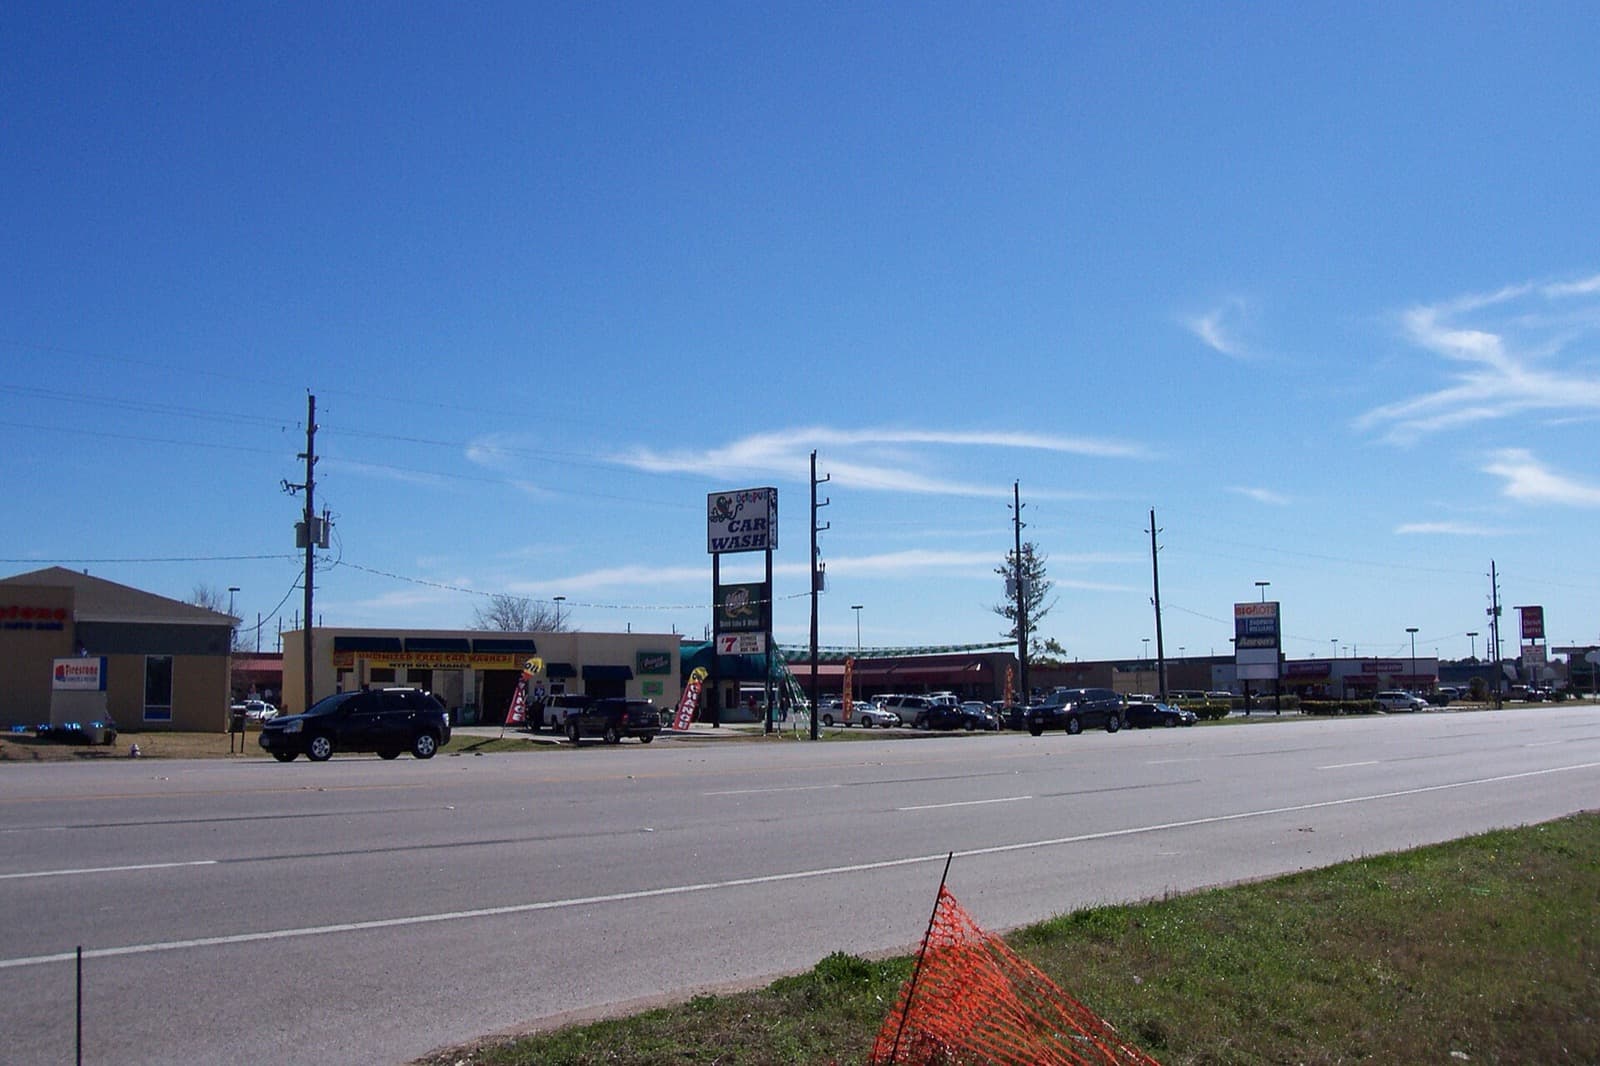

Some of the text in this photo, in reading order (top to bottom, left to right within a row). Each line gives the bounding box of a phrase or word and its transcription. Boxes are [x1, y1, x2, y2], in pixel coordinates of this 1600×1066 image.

[728, 518, 766, 533] CAR
[711, 534, 766, 550] WASH
[416, 653, 441, 661] FREE
[446, 653, 466, 662] CAR
[65, 664, 98, 675] Firestone
[524, 662, 539, 673] OIL
[678, 684, 697, 729] CHANGE
